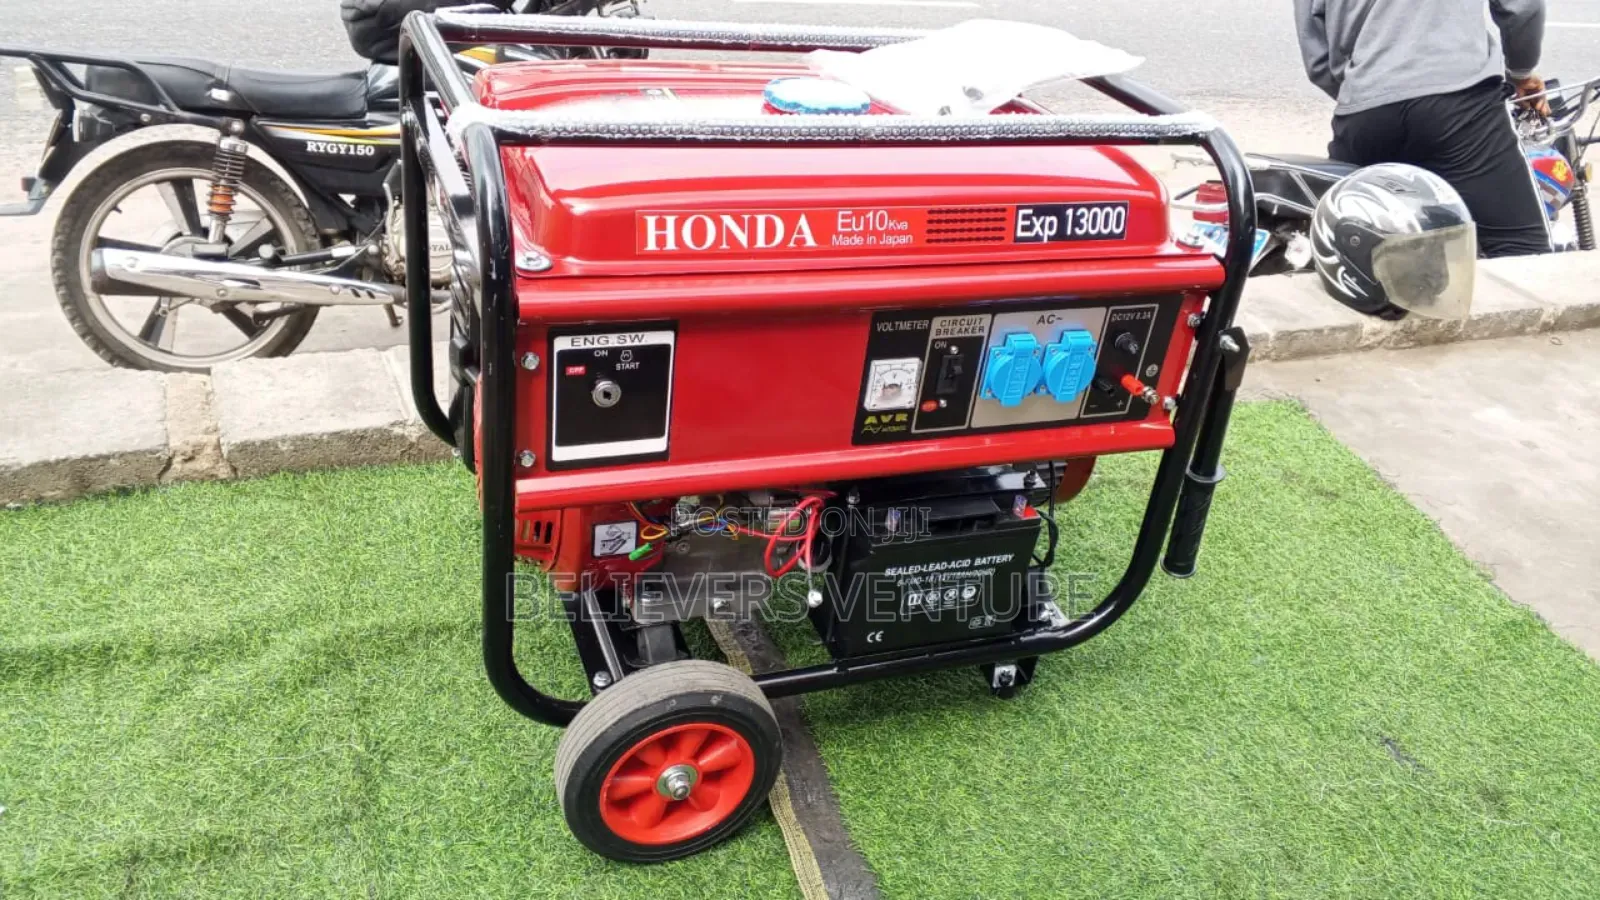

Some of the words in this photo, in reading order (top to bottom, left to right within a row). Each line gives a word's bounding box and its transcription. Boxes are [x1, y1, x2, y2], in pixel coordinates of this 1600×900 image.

[306, 141, 375, 156] RYGY150
[1016, 209, 1057, 241] Exp
[1065, 206, 1126, 235] 13000
[643, 213, 818, 250] HONDA
[831, 234, 864, 246] Made
[866, 233, 877, 245] in
[879, 232, 913, 248] Japan
[876, 320, 929, 331] VOLTMETER
[940, 318, 983, 327] CIRCUIT
[935, 326, 985, 336] BREAKER
[615, 362, 640, 371] START
[885, 559, 971, 576] SEALED-LEAD-ACID
[974, 553, 1015, 567] BATTERY
